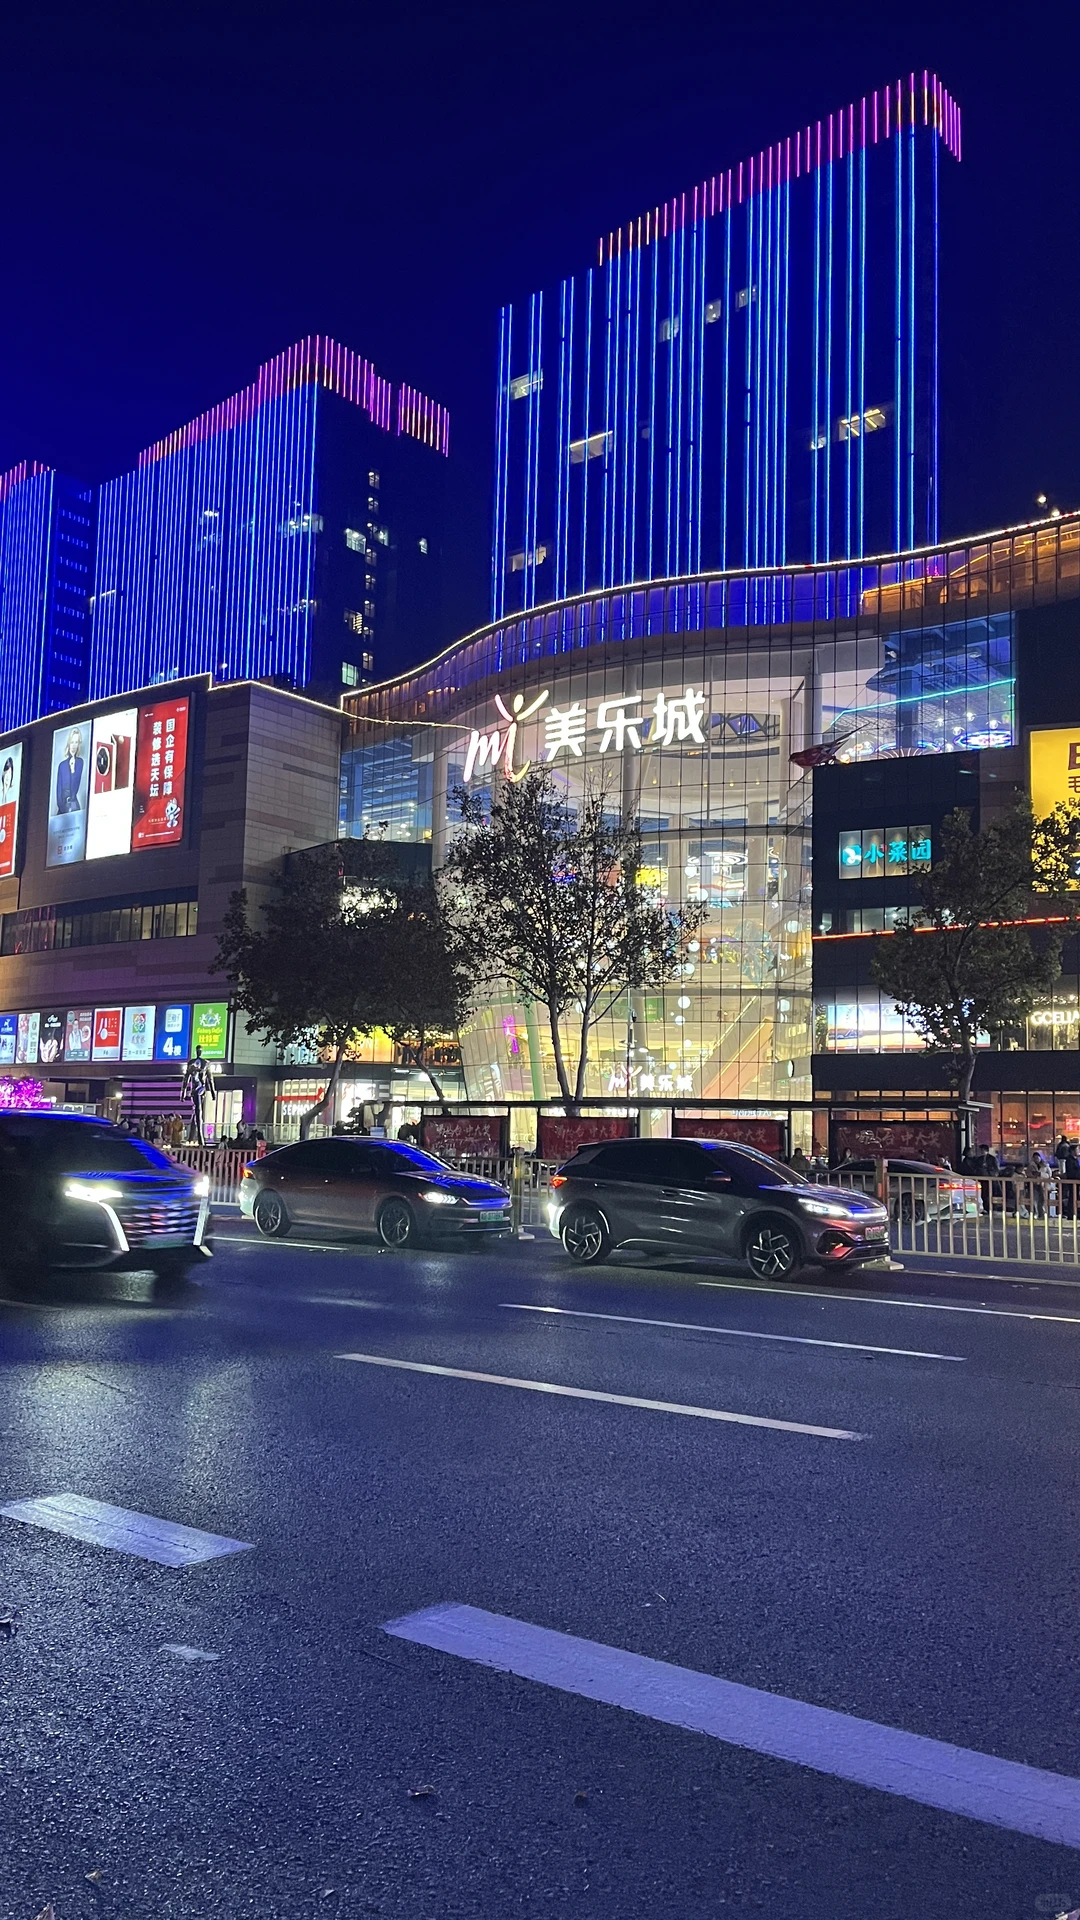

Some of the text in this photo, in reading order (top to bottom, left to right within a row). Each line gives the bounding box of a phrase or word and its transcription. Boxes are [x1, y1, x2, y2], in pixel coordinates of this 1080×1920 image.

[150, 721, 162, 797] 装修选天坛
[163, 718, 175, 796] 国企有保障
[544, 688, 706, 762] 美乐城
[863, 839, 932, 864] 小菜园
